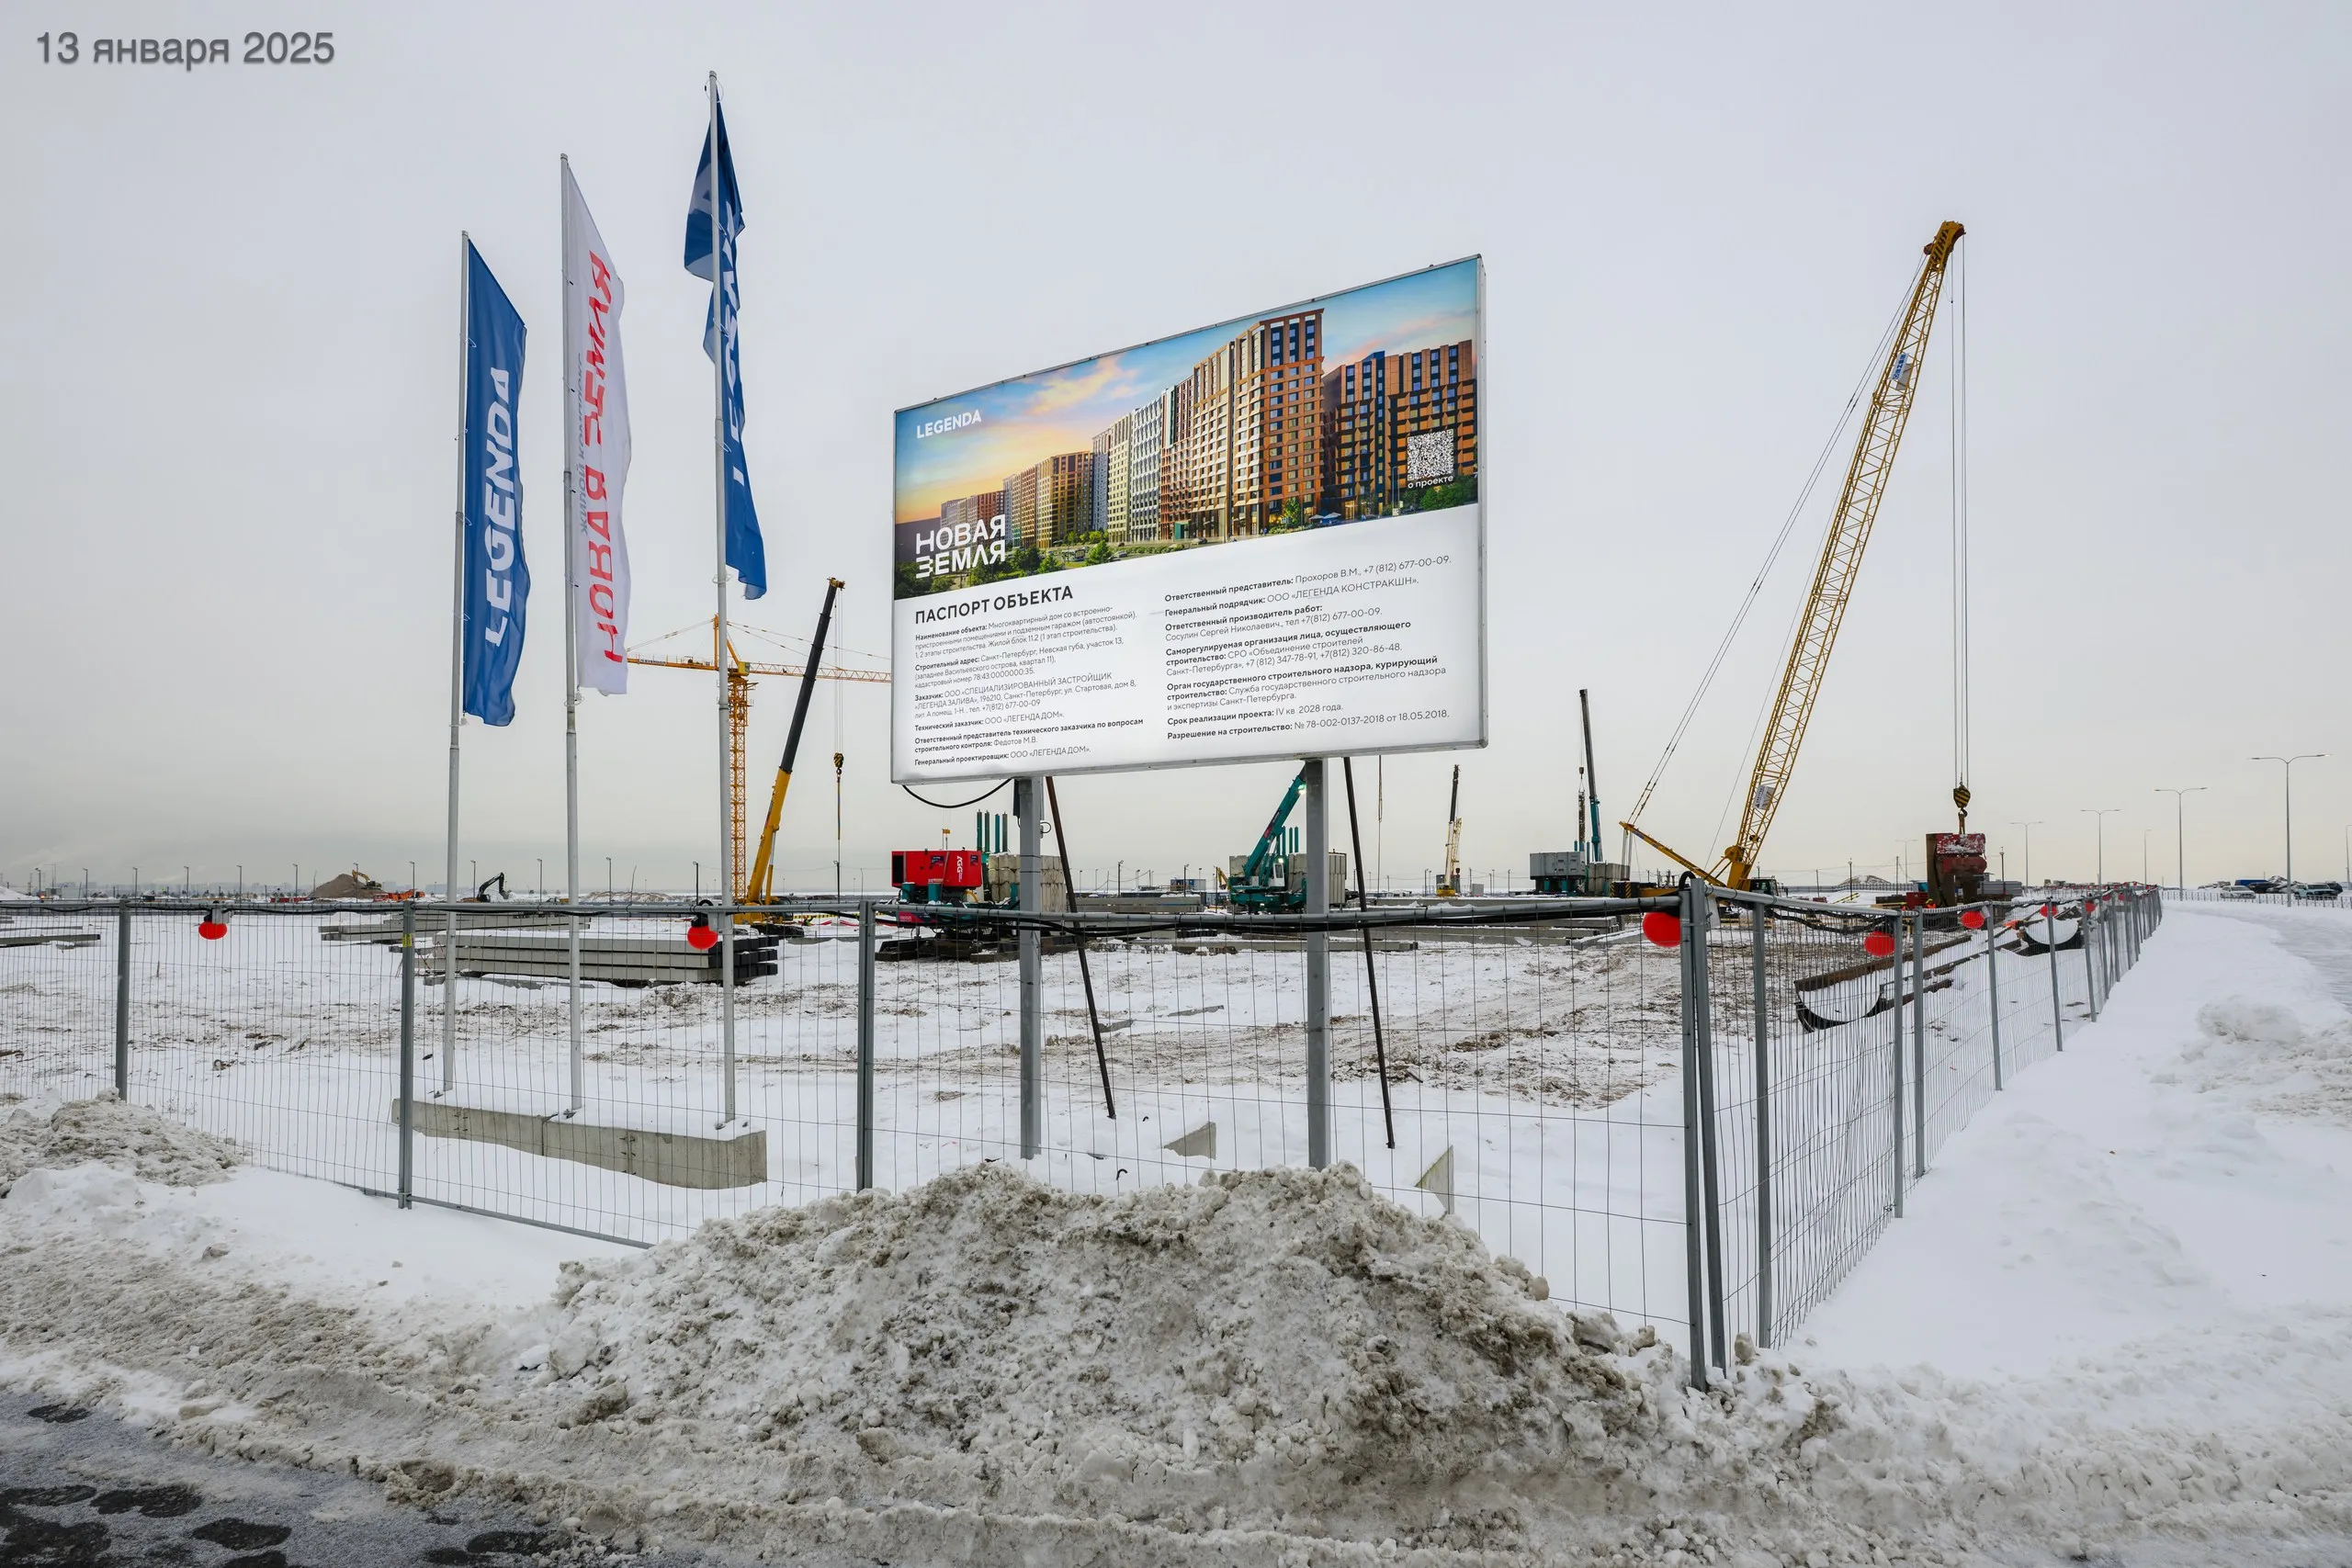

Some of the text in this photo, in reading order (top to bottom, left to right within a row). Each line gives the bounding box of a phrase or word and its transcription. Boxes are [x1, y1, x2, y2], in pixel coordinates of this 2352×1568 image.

[917, 410, 981, 439] LEGENDA
[1416, 476, 1453, 488] проекте
[485, 367, 515, 648] LEGENDA
[916, 514, 1005, 555] НОВАЯ
[584, 465, 623, 663] НОВАЯ
[916, 540, 1005, 579] ЗЕМЛЯ
[1165, 586, 1227, 603] Ответственный
[1228, 579, 1295, 595] представитель:
[1295, 572, 1340, 585] Прохоров
[1363, 566, 1374, 574] +7
[1375, 562, 1397, 575] (812)
[1398, 555, 1452, 570] 677-00-09.
[916, 585, 1074, 624] ПАСПОРТ ОБЪЕКТА
[1165, 603, 1218, 617] Генеральный
[1218, 598, 1266, 610] подрядчик:
[1267, 592, 1291, 604] ООО
[1165, 604, 1323, 632] Ответственный производитель работ:
[915, 637, 963, 650] пристроенными
[963, 631, 1007, 642] помещениями
[1012, 625, 1051, 636] подземным
[1052, 620, 1081, 630] гаражом
[916, 629, 960, 641] Наименование
[961, 626, 988, 634] объекта:
[989, 614, 1048, 630] Многоквартирный
[1049, 614, 1063, 622] дом
[1073, 606, 1114, 617] встроенно-
[1166, 632, 1199, 641] Сосулин
[1200, 626, 1230, 637] Сергей
[1301, 613, 1331, 625] +7(812)
[1331, 606, 1383, 621] 677-00-09.
[988, 638, 1011, 649] Жилой
[1166, 621, 1411, 656] Саморегулируемая организация лица, осуществляющего
[1166, 636, 1363, 667] строительство: СРО «Объединение строителей
[915, 659, 959, 671] Строительный
[960, 658, 980, 666] адрес:
[981, 649, 1038, 662] Санкт-Петербург,
[1039, 646, 1068, 655] Невская
[1086, 639, 1114, 650] участок
[1115, 637, 1125, 645] 13,
[1167, 642, 1402, 676] Санкт-Петербурга», +7 (812) 347-78-91, +7(812) 320-86-48.
[915, 671, 944, 681] (западнее
[944, 665, 990, 676] Васильевского
[990, 661, 1019, 671] острова,
[1020, 658, 1046, 666] квартал
[915, 677, 953, 688] кадастровый
[1167, 655, 1438, 692] Орган государственного строительного надзора, курирующий
[944, 689, 961, 698] ООО
[961, 677, 1057, 695] «СПЕЦИАЛИЗИРОВАННЫЙ
[1057, 671, 1113, 685] ЗАСТРОЙЩИК
[980, 694, 1003, 703] 196210,
[1003, 689, 1064, 701] Санкт-Петербург,
[1075, 683, 1114, 693] Стартовая,
[1114, 682, 1129, 690] дом
[1167, 667, 1446, 702] строительство: Служба государственного строительного надзора
[983, 702, 1004, 712] +7(812)
[1005, 698, 1041, 709] 677-00-09
[1168, 717, 1188, 727] Срок
[1189, 714, 1237, 725] реализации
[1238, 710, 1275, 720] проекта:
[1275, 707, 1285, 716] IV
[1299, 704, 1321, 714] 2028
[1174, 701, 1219, 710] экспертизы
[1219, 693, 1297, 705] Санкт-Петербурга.
[915, 721, 954, 731] Технический
[985, 716, 1002, 725] ООО
[915, 734, 963, 744] Ответственный
[963, 730, 1012, 741] представитель
[1012, 727, 1059, 736] технического
[1060, 723, 1096, 731] заказчика
[1108, 718, 1144, 728] вопросам
[1168, 730, 1216, 740] Разрешение
[1229, 724, 1294, 736] строительство:
[1295, 721, 1306, 729] №
[1306, 715, 1385, 728] 78-002-0137-2018
[1398, 709, 1450, 721] 18.05.2018.
[915, 744, 960, 754] строительного
[961, 741, 993, 750] контроля:
[915, 756, 956, 766] Генеральный
[956, 753, 1010, 763] проектировщик:
